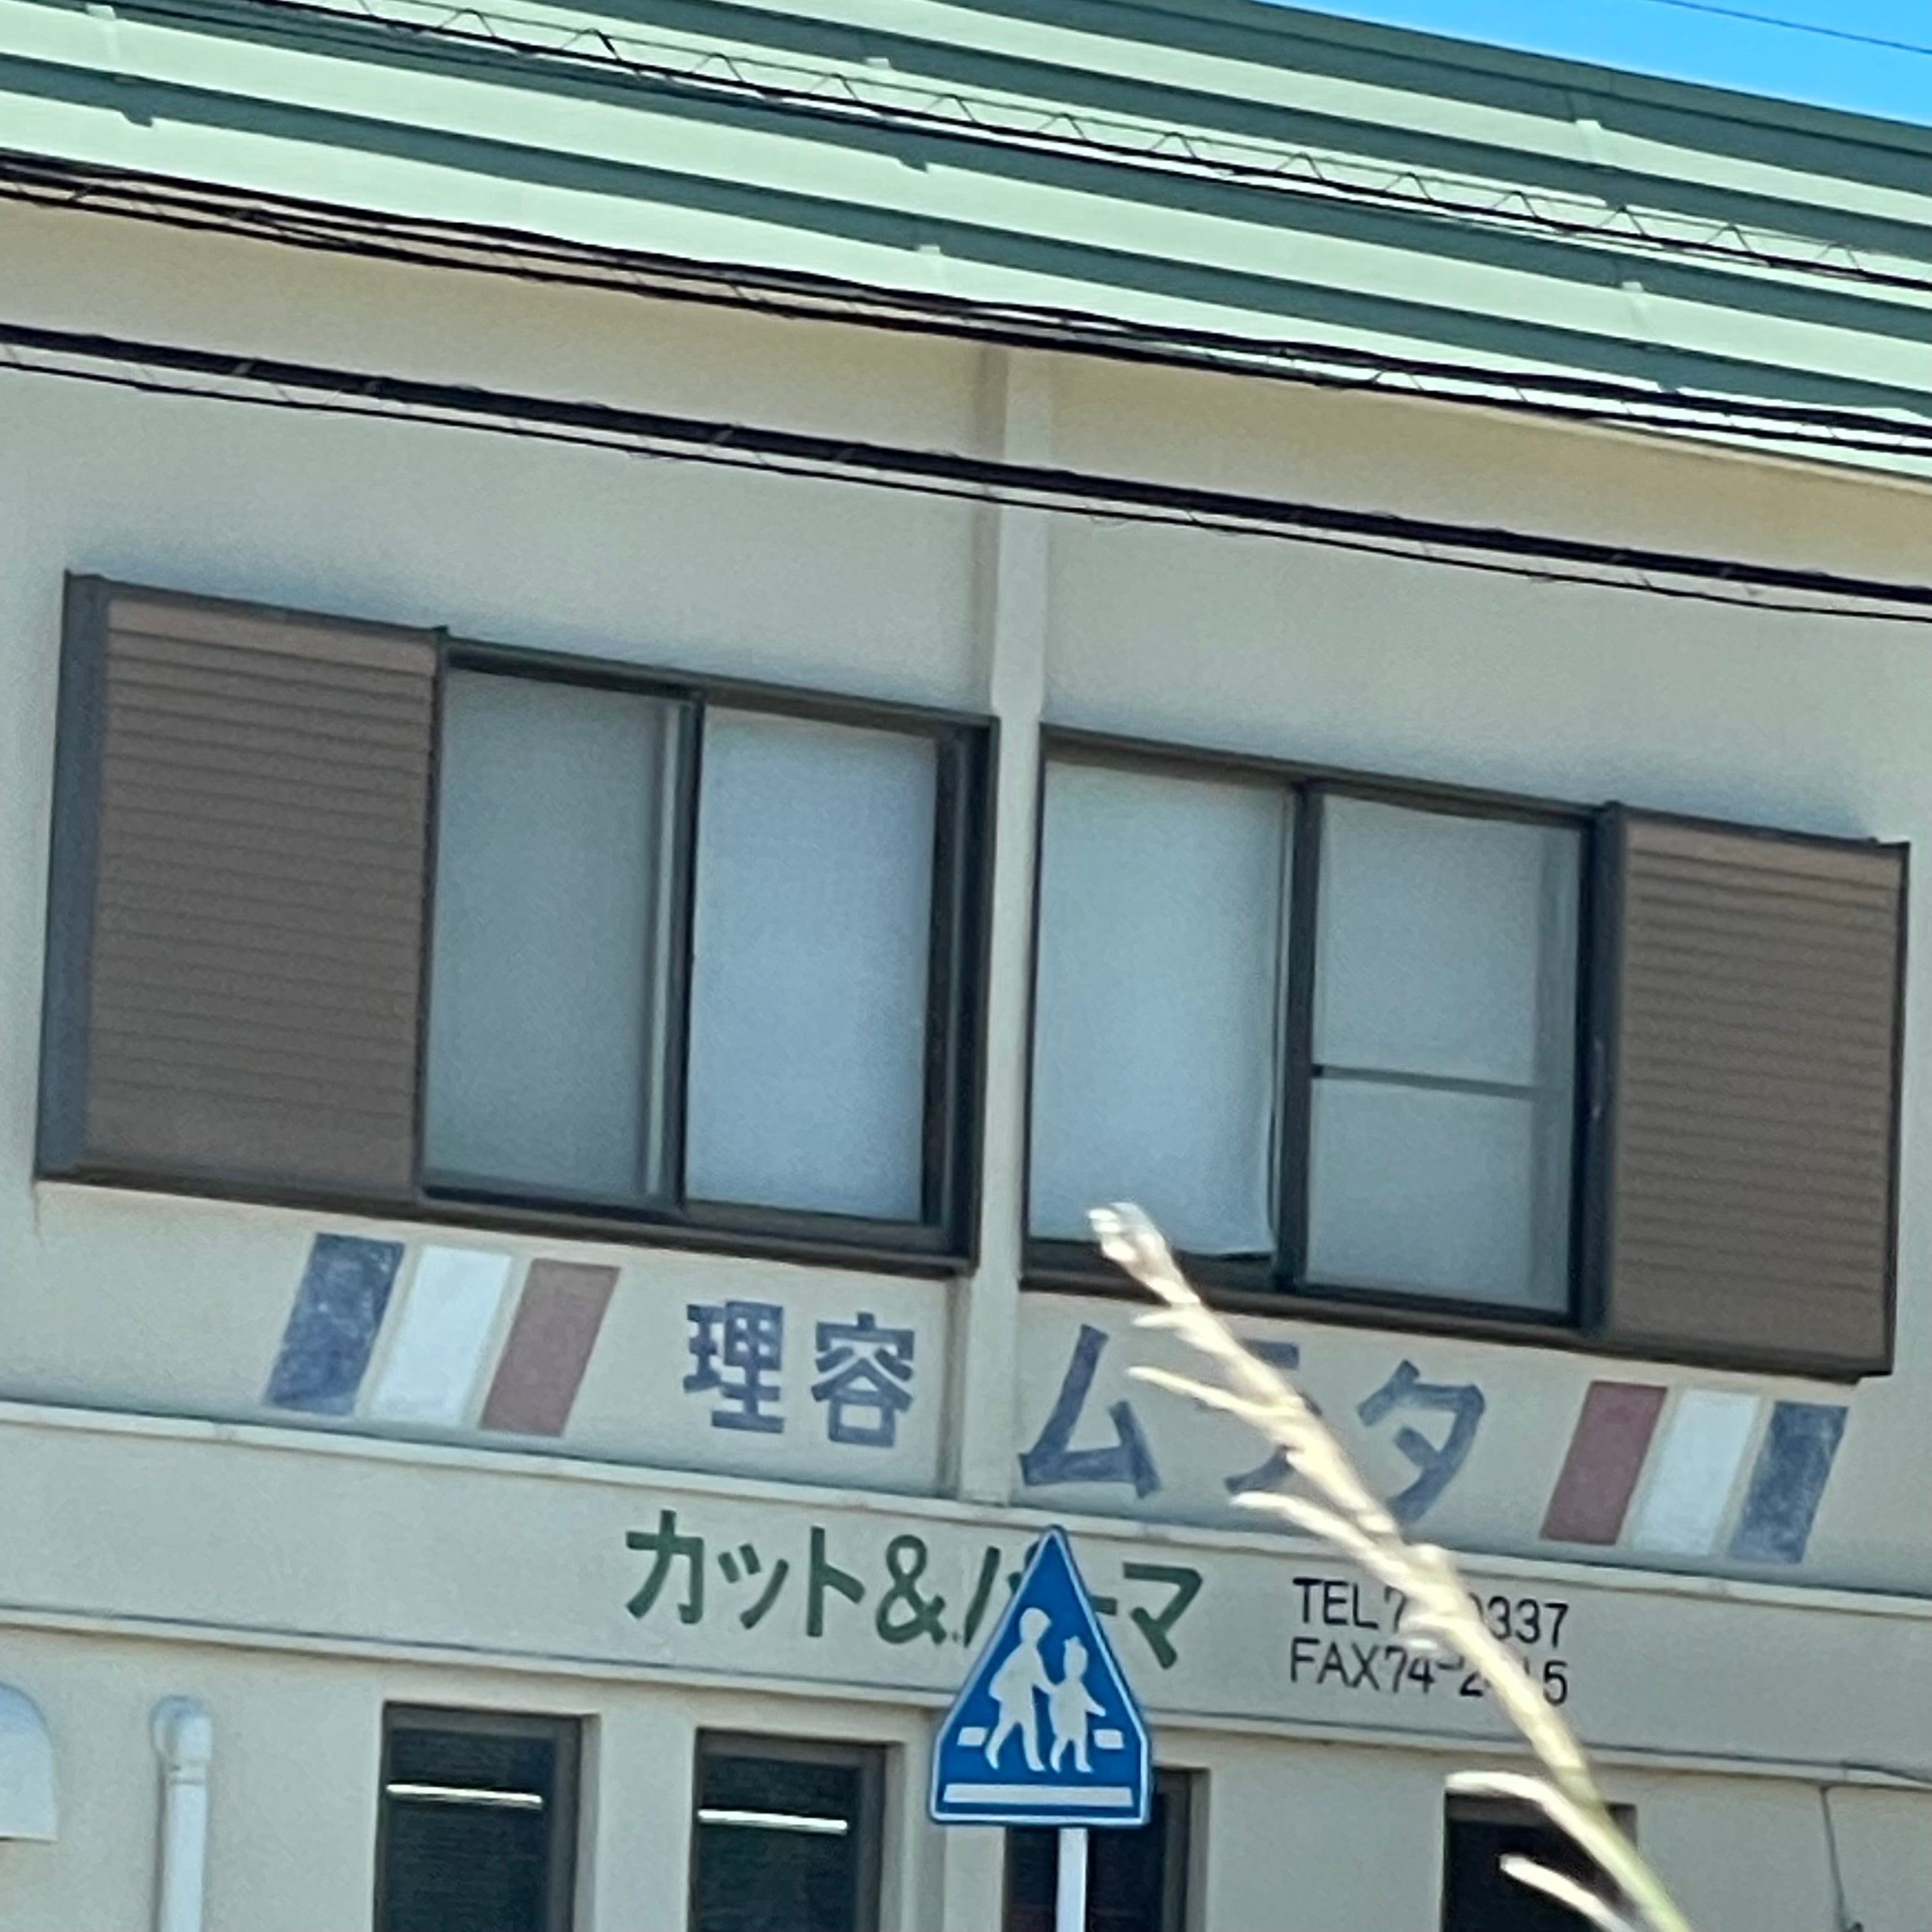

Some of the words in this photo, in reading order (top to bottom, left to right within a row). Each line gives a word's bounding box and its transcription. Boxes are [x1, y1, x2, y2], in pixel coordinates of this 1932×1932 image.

[682, 1300, 915, 1448] 理容
[625, 1509, 1203, 1670] カット&マ
